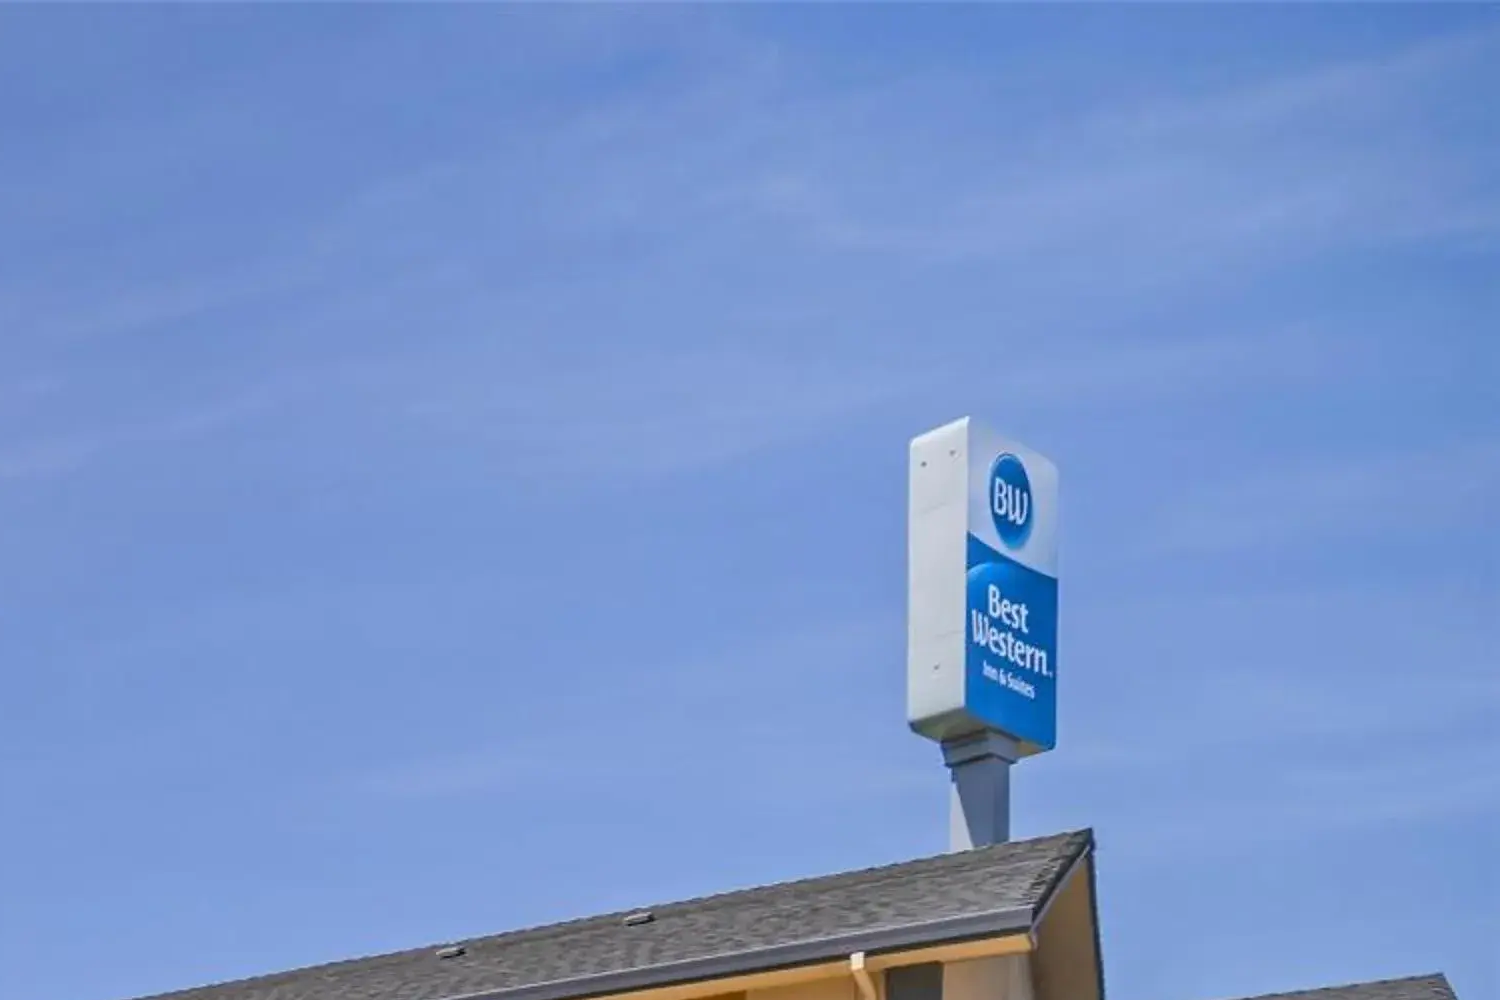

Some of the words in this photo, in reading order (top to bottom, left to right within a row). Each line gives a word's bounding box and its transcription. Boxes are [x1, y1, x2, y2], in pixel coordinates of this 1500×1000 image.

[993, 477, 1028, 525] BW
[988, 584, 1029, 634] Best
[971, 608, 1049, 677] Western
